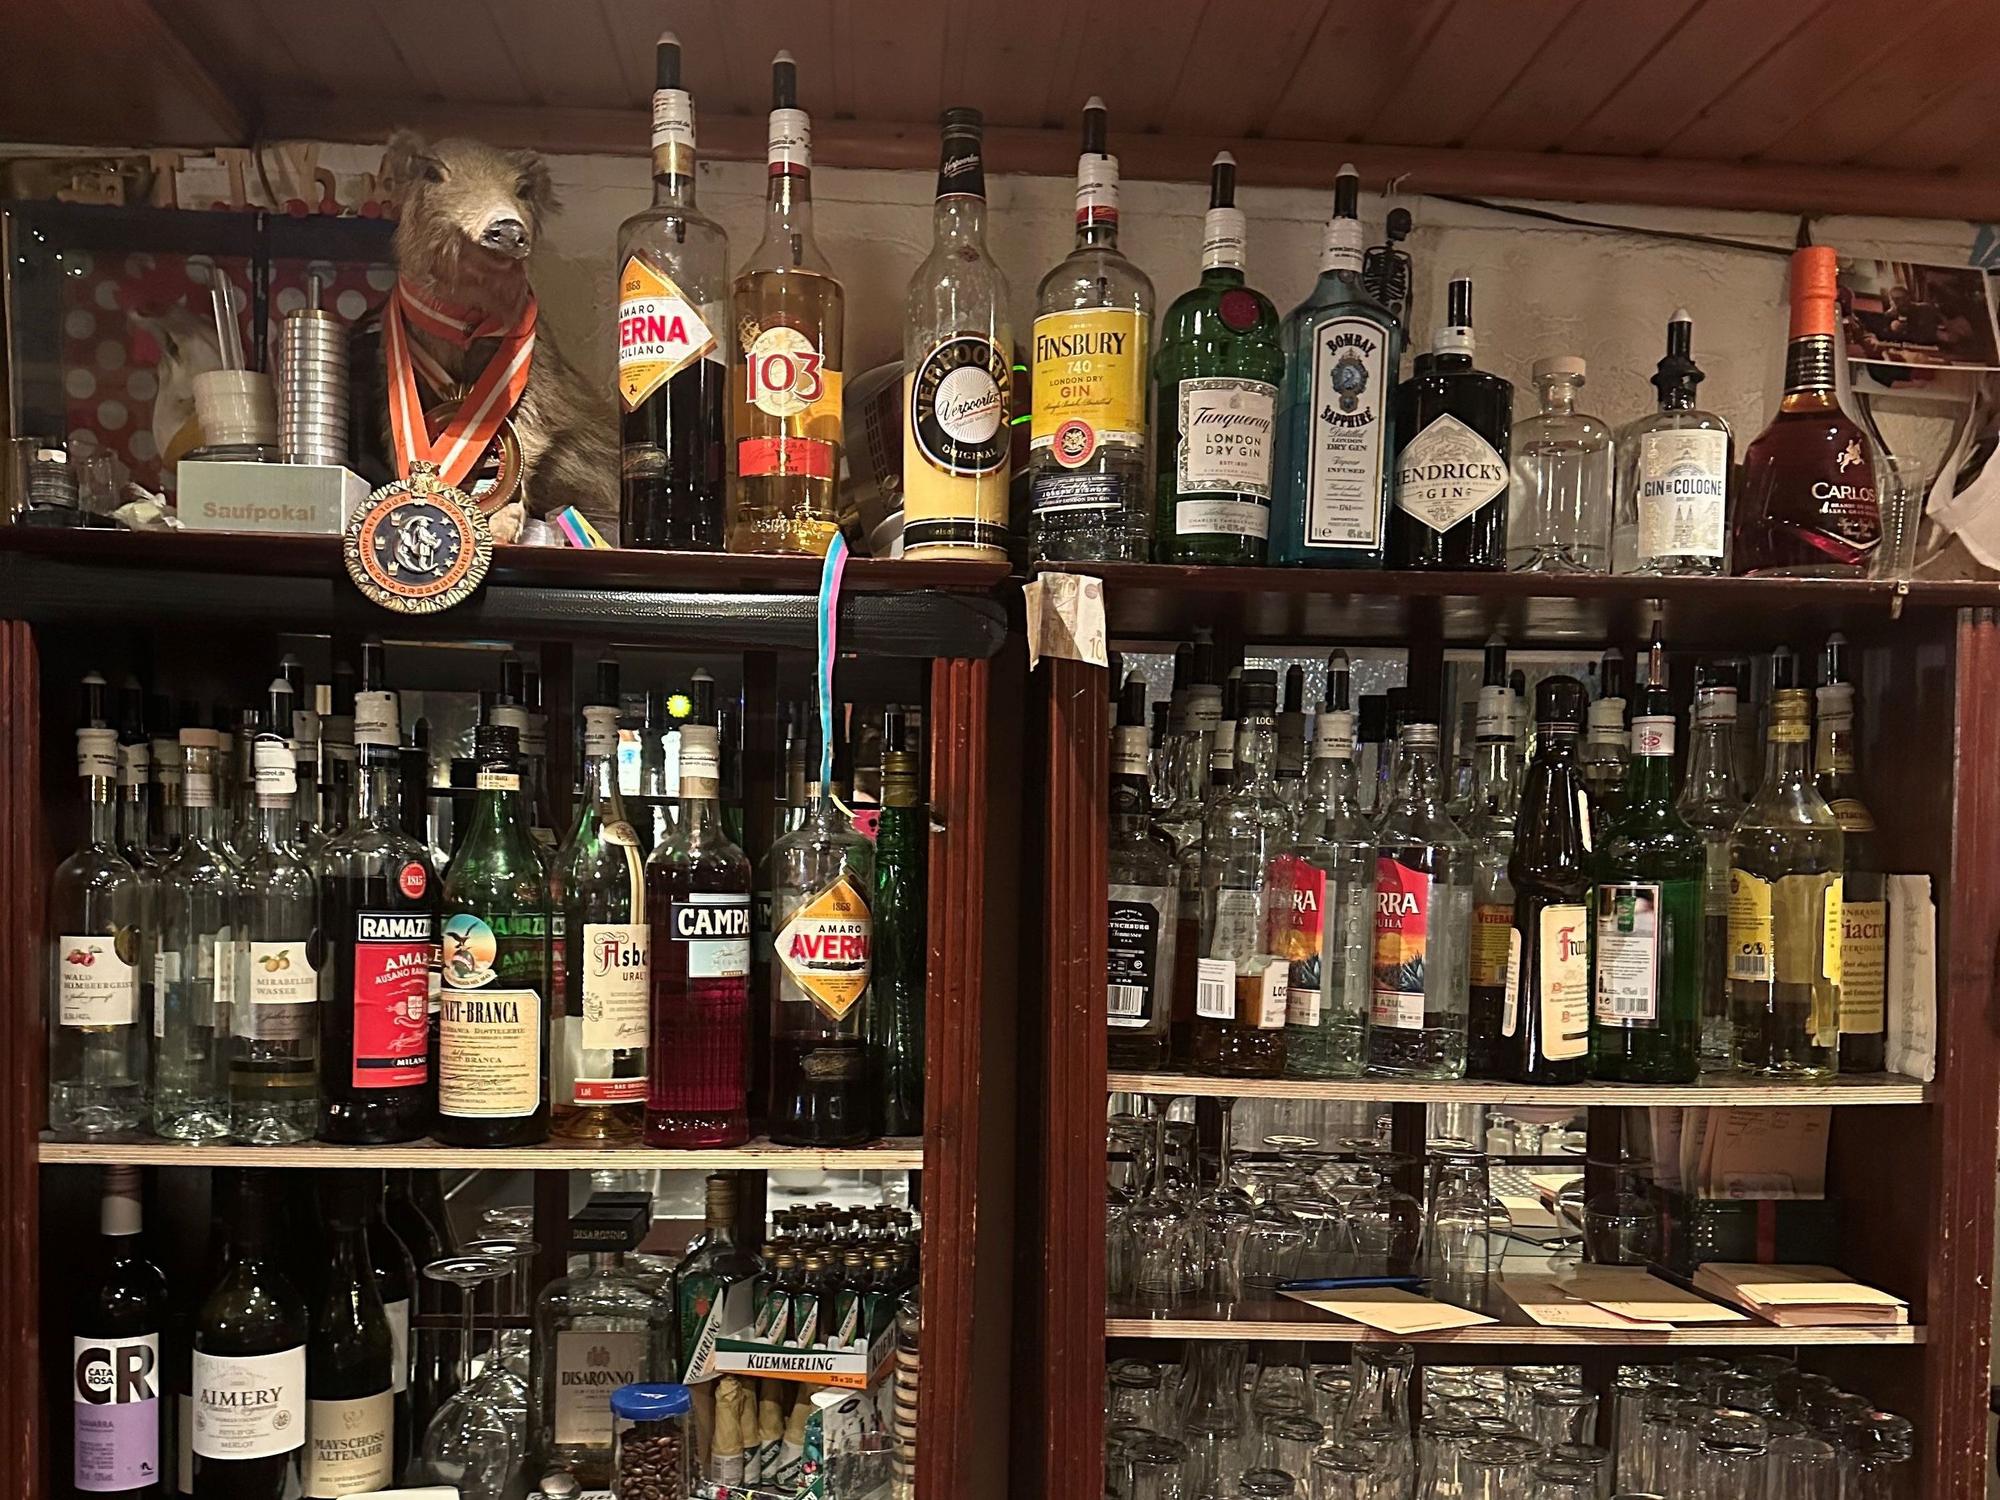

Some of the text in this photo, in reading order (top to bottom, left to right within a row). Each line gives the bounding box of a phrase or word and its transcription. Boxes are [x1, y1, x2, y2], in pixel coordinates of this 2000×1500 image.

[1036, 332, 1128, 364] FINSBURY
[1326, 333, 1377, 356] BOMBAY
[746, 351, 825, 403] 103
[1050, 375, 1104, 387] LONDON DRY
[1060, 384, 1091, 399] GIN
[1193, 407, 1271, 434] Tanqueray
[1320, 405, 1376, 429] SAPPHIRE
[1206, 433, 1262, 446] LONDON
[941, 442, 998, 460] ORIGINAL
[1205, 445, 1261, 458] DRY GIN
[1348, 444, 1368, 452] GIN
[1426, 487, 1463, 499] GIN
[1644, 481, 1665, 497] GIN
[1674, 479, 1722, 495] COLOGNE
[1811, 482, 1876, 502] CARLOS
[203, 502, 317, 522] Saufpokal
[1089, 637, 1105, 660] 10
[406, 875, 424, 886] 1815
[818, 924, 862, 934] AMARO
[375, 969, 410, 985] AUSANO
[256, 986, 296, 995] WASSER
[464, 1056, 502, 1064] BRANCA
[573, 1229, 628, 1241] DISARONNO
[748, 1353, 834, 1372] KUEMMERLING
[88, 1367, 114, 1378] CATA
[562, 1370, 634, 1386] DISARONNO
[830, 1375, 839, 1383] 25
[844, 1376, 853, 1385] 20
[88, 1376, 114, 1386] ROSA
[200, 1386, 284, 1408] AIMERY
[318, 1444, 383, 1462] ALTENAHR
